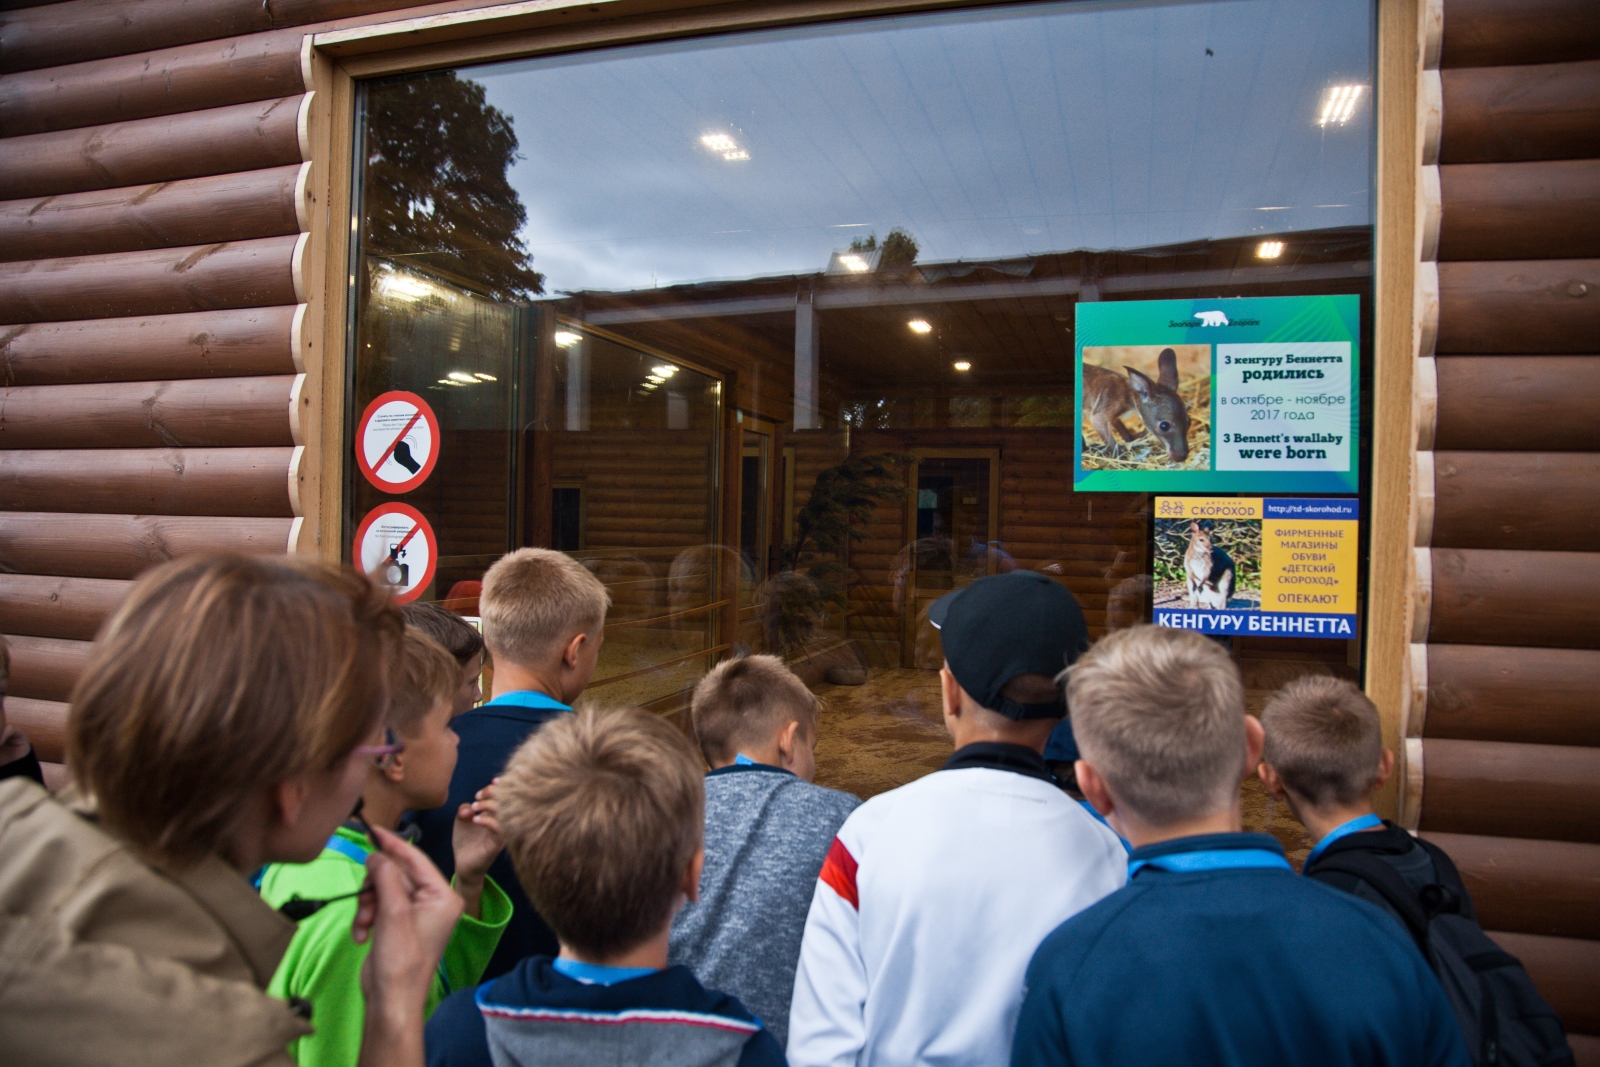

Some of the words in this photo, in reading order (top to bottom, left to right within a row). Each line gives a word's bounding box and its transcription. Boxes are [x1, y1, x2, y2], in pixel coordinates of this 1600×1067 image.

[1234, 356, 1283, 367] кенгуру
[1285, 353, 1343, 364] Беннетта
[1242, 369, 1325, 383] родились
[1221, 396, 1227, 405] в
[1230, 393, 1284, 407] октябре
[1295, 392, 1346, 407] ноябре
[1250, 409, 1280, 420] 2017
[1283, 410, 1315, 421] года
[1223, 433, 1231, 443] 3
[1233, 433, 1290, 443] Bennett's
[1292, 432, 1343, 445] wallaby
[1238, 449, 1282, 459] were
[1286, 445, 1327, 459] born
[1267, 504, 1353, 514] http://td-skorohod.ru
[1274, 529, 1345, 538] ФИРМЕННЫЕ
[1280, 541, 1338, 550] МАГАЗИНЫ
[1291, 552, 1327, 561] ОБУВИ
[1277, 593, 1340, 604] ОПЕКАЮТ
[1158, 612, 1245, 630] КЕНГУРУ
[1248, 615, 1352, 634] БЕННЕТТА
